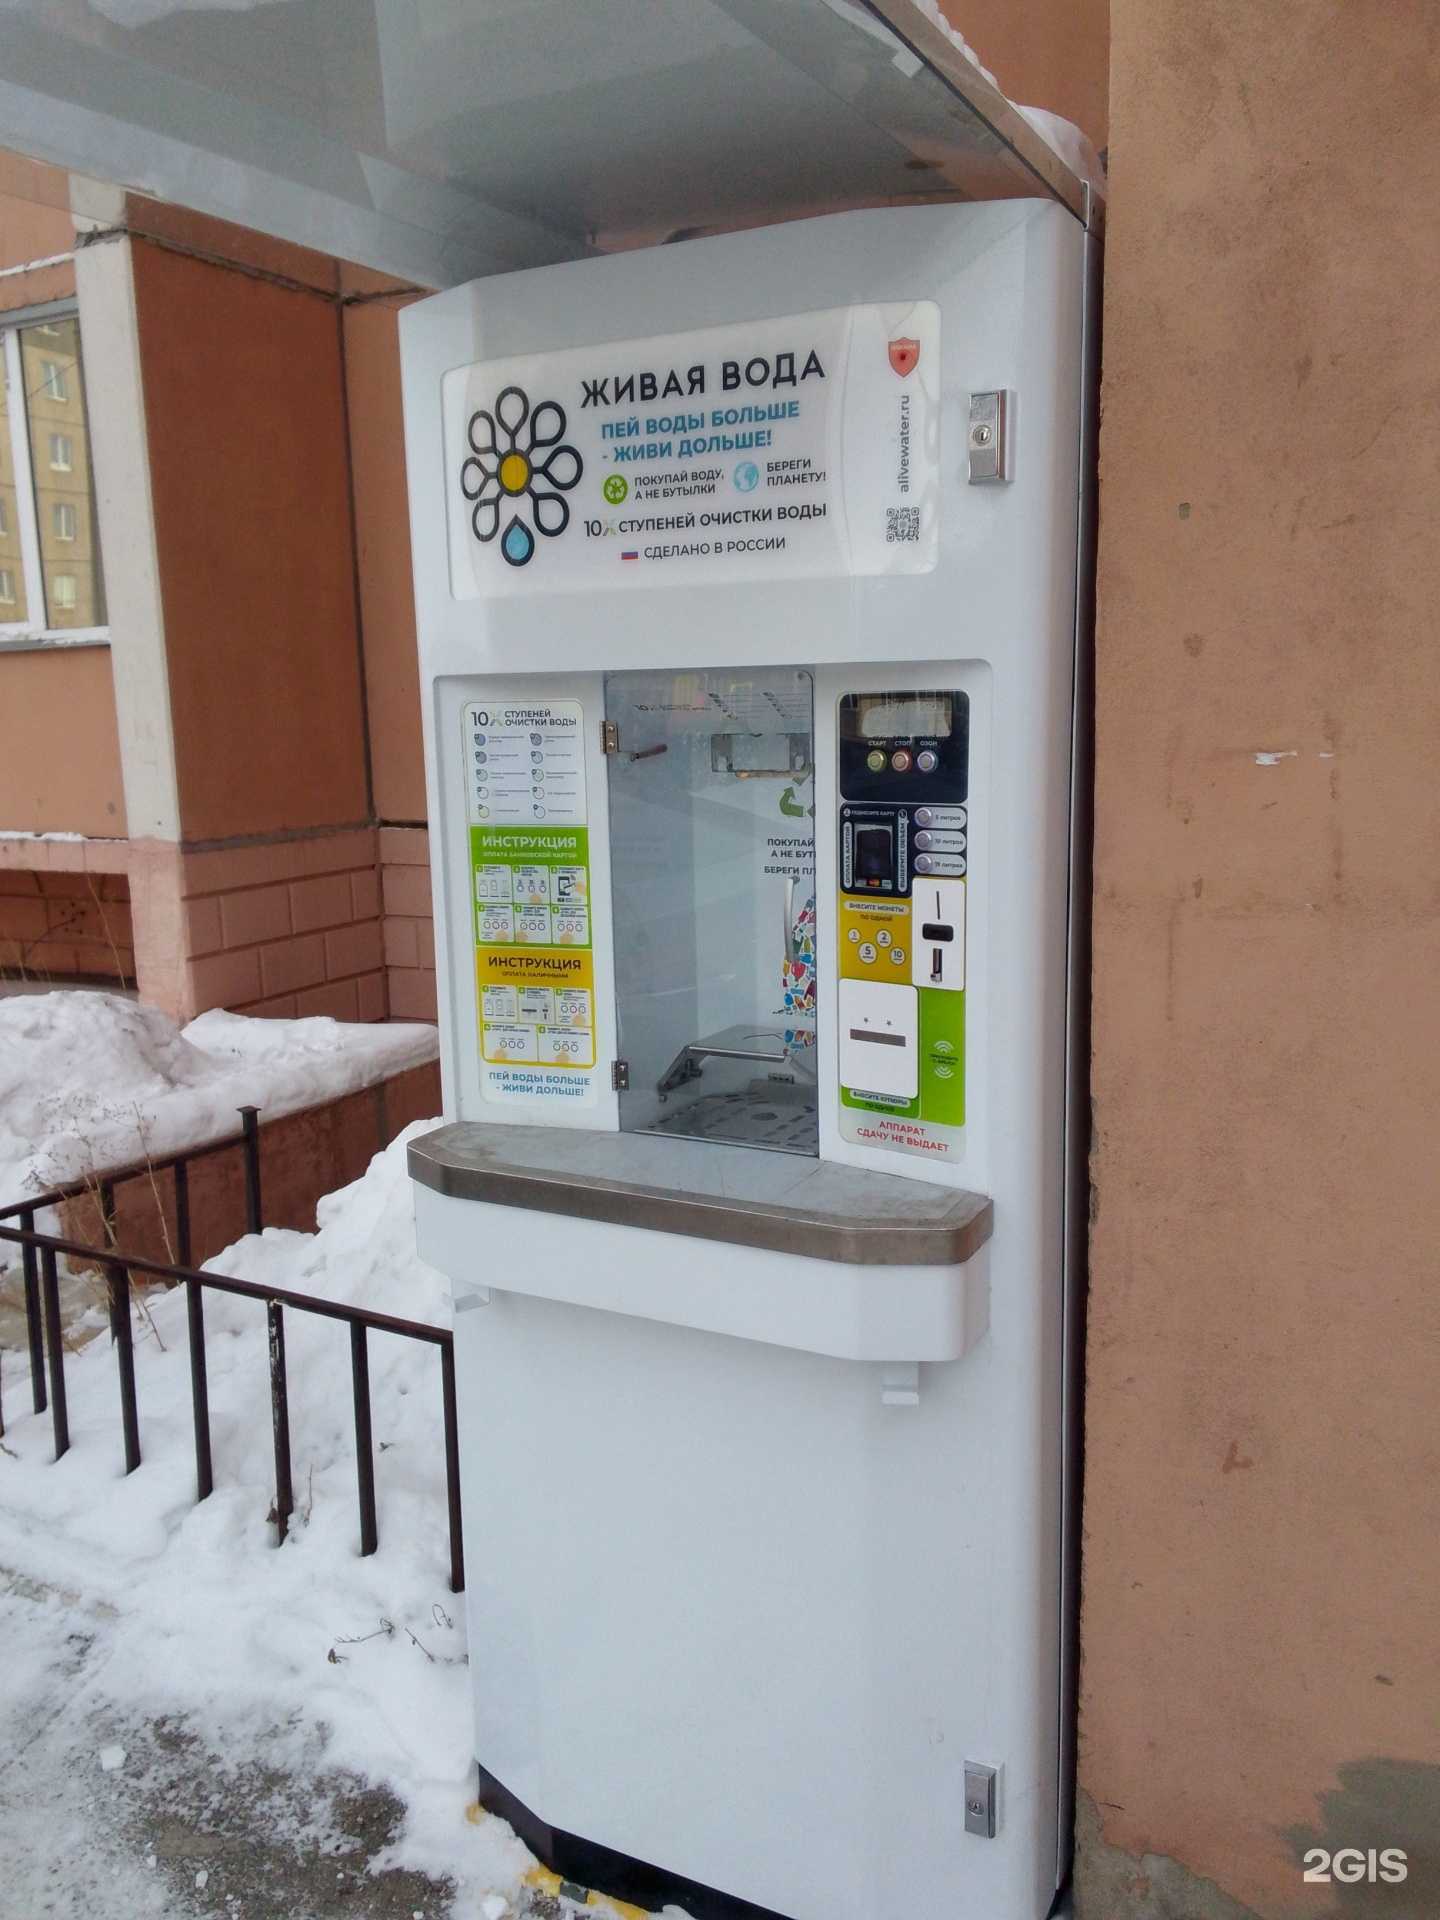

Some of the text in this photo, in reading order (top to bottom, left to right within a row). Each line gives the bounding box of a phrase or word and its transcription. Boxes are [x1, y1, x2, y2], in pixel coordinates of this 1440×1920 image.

[581, 350, 825, 408] ЖИВАЯ ВОДА
[602, 401, 800, 440] ПЕЙ ВОДЫ БОЛЬШЕ
[614, 441, 672, 463] ЖИВИ
[678, 430, 772, 458] ДОЛЬШЕ!
[897, 395, 910, 493] alivewater.ru
[767, 459, 811, 472] БЕРЕГИ
[635, 468, 724, 487] ПОКУПАЙ ВОДУ,
[767, 471, 826, 487] ПЛАНЕТУ!
[635, 484, 716, 500] А НЕ БУТЫЛКИ
[619, 513, 695, 533] СТУПЕНЕЙ
[700, 507, 772, 526] ОЧИСТКИ
[777, 503, 827, 520] ВОДЫ
[644, 537, 786, 560] СДЕЛАНО В РОССИИ
[504, 709, 551, 718] СТУПЕНЕЙ
[549, 718, 577, 727] ВОДЫ
[482, 835, 577, 849] ИНСТРУКЦИЯ
[767, 837, 815, 847] ПОКУПАЙ
[764, 866, 800, 874] БЕРЕГИ
[880, 932, 887, 940] 2
[865, 946, 871, 955] 5
[893, 950, 902, 958] 10
[488, 957, 581, 970] ИНСТРУКЦИЯ
[489, 1071, 590, 1085] ПЕЙ ВОДЫ БОЛЬШЕ
[502, 1084, 533, 1093] ЖИВИ
[536, 1085, 584, 1096] ДОЛЬШЕ!
[880, 1121, 927, 1136] АППАРАТ
[857, 1128, 950, 1152] СДАЧУ НЕ ВЫДАЕТ
